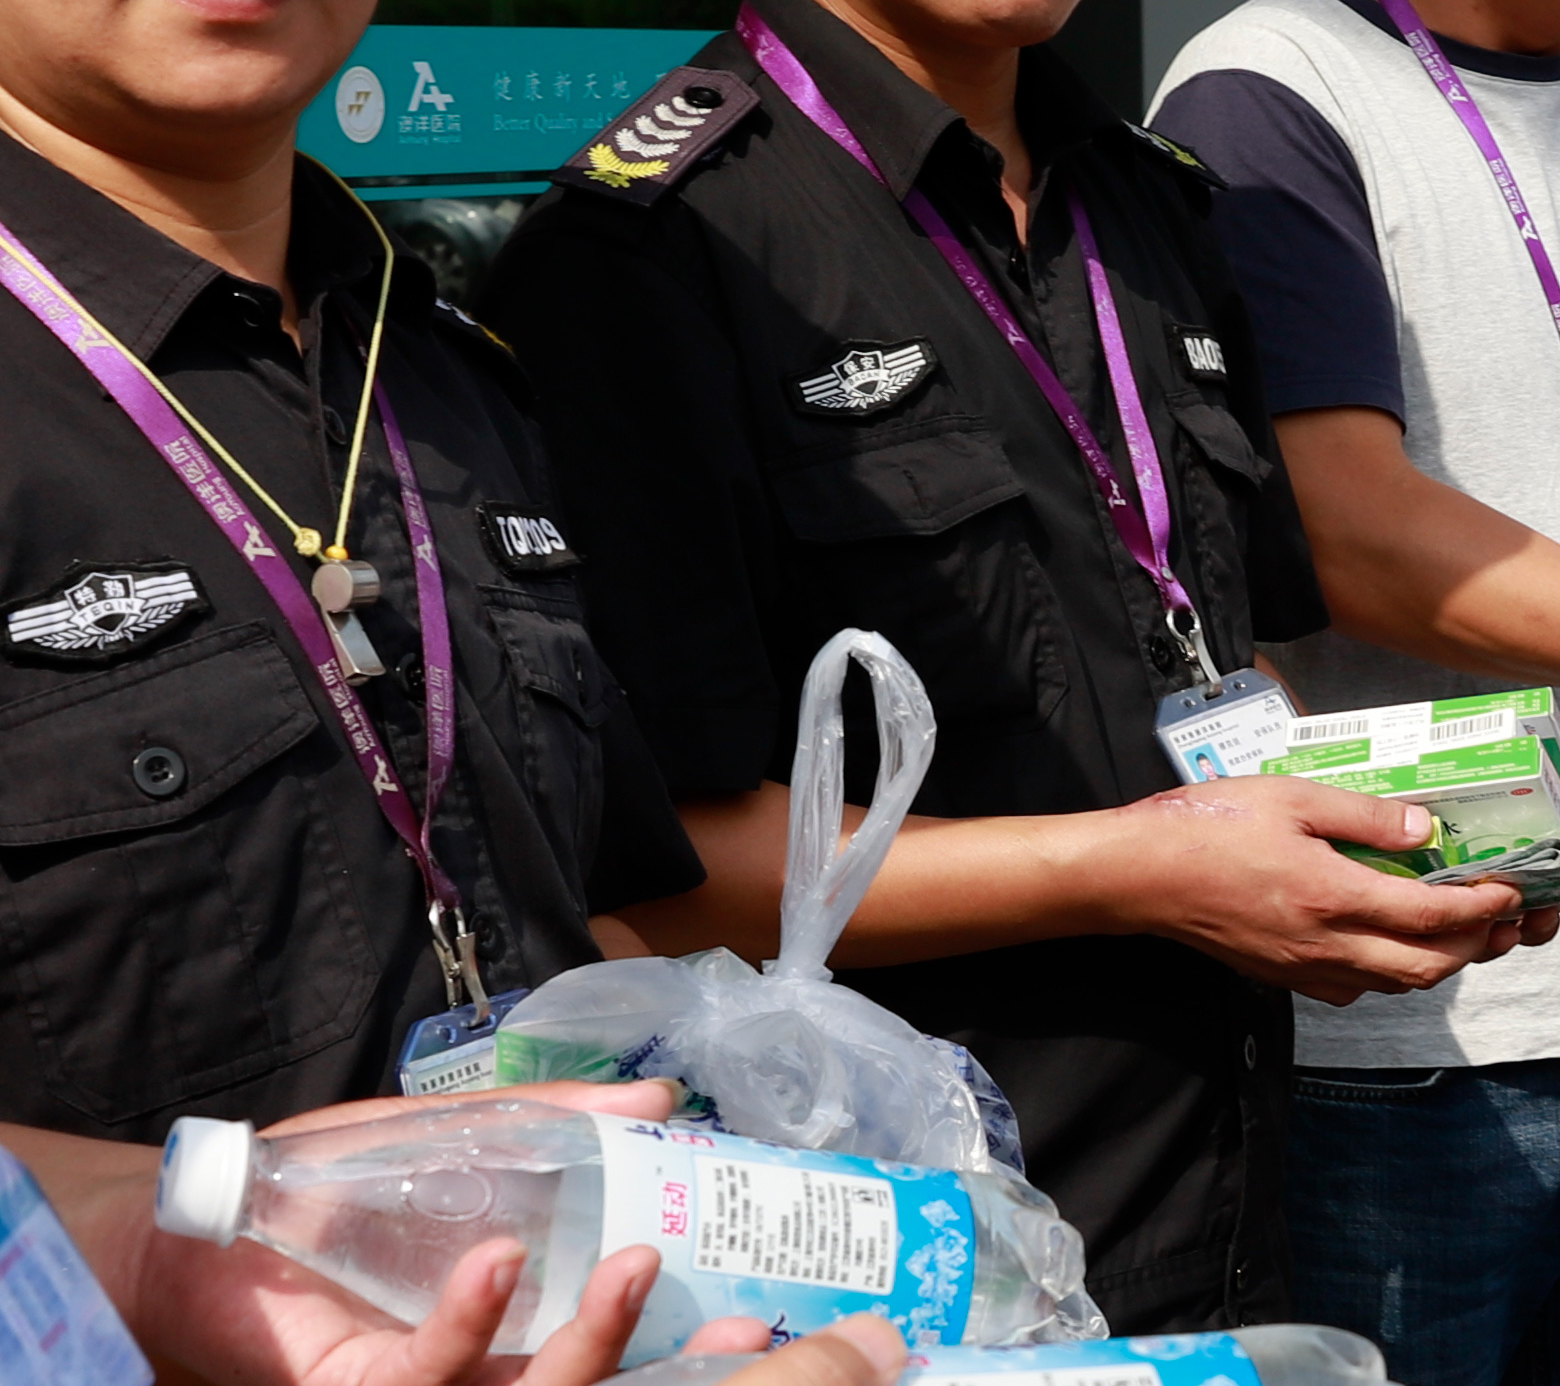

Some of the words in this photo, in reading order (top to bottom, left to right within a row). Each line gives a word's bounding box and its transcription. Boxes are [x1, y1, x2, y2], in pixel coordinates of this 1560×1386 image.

[161, 435, 238, 526] 澳洋医院
[177, 433, 212, 475] Hospital
[82, 600, 135, 621] TEQIN
[317, 660, 371, 755] 澳洋医院
[661, 1181, 689, 1237] 延动
